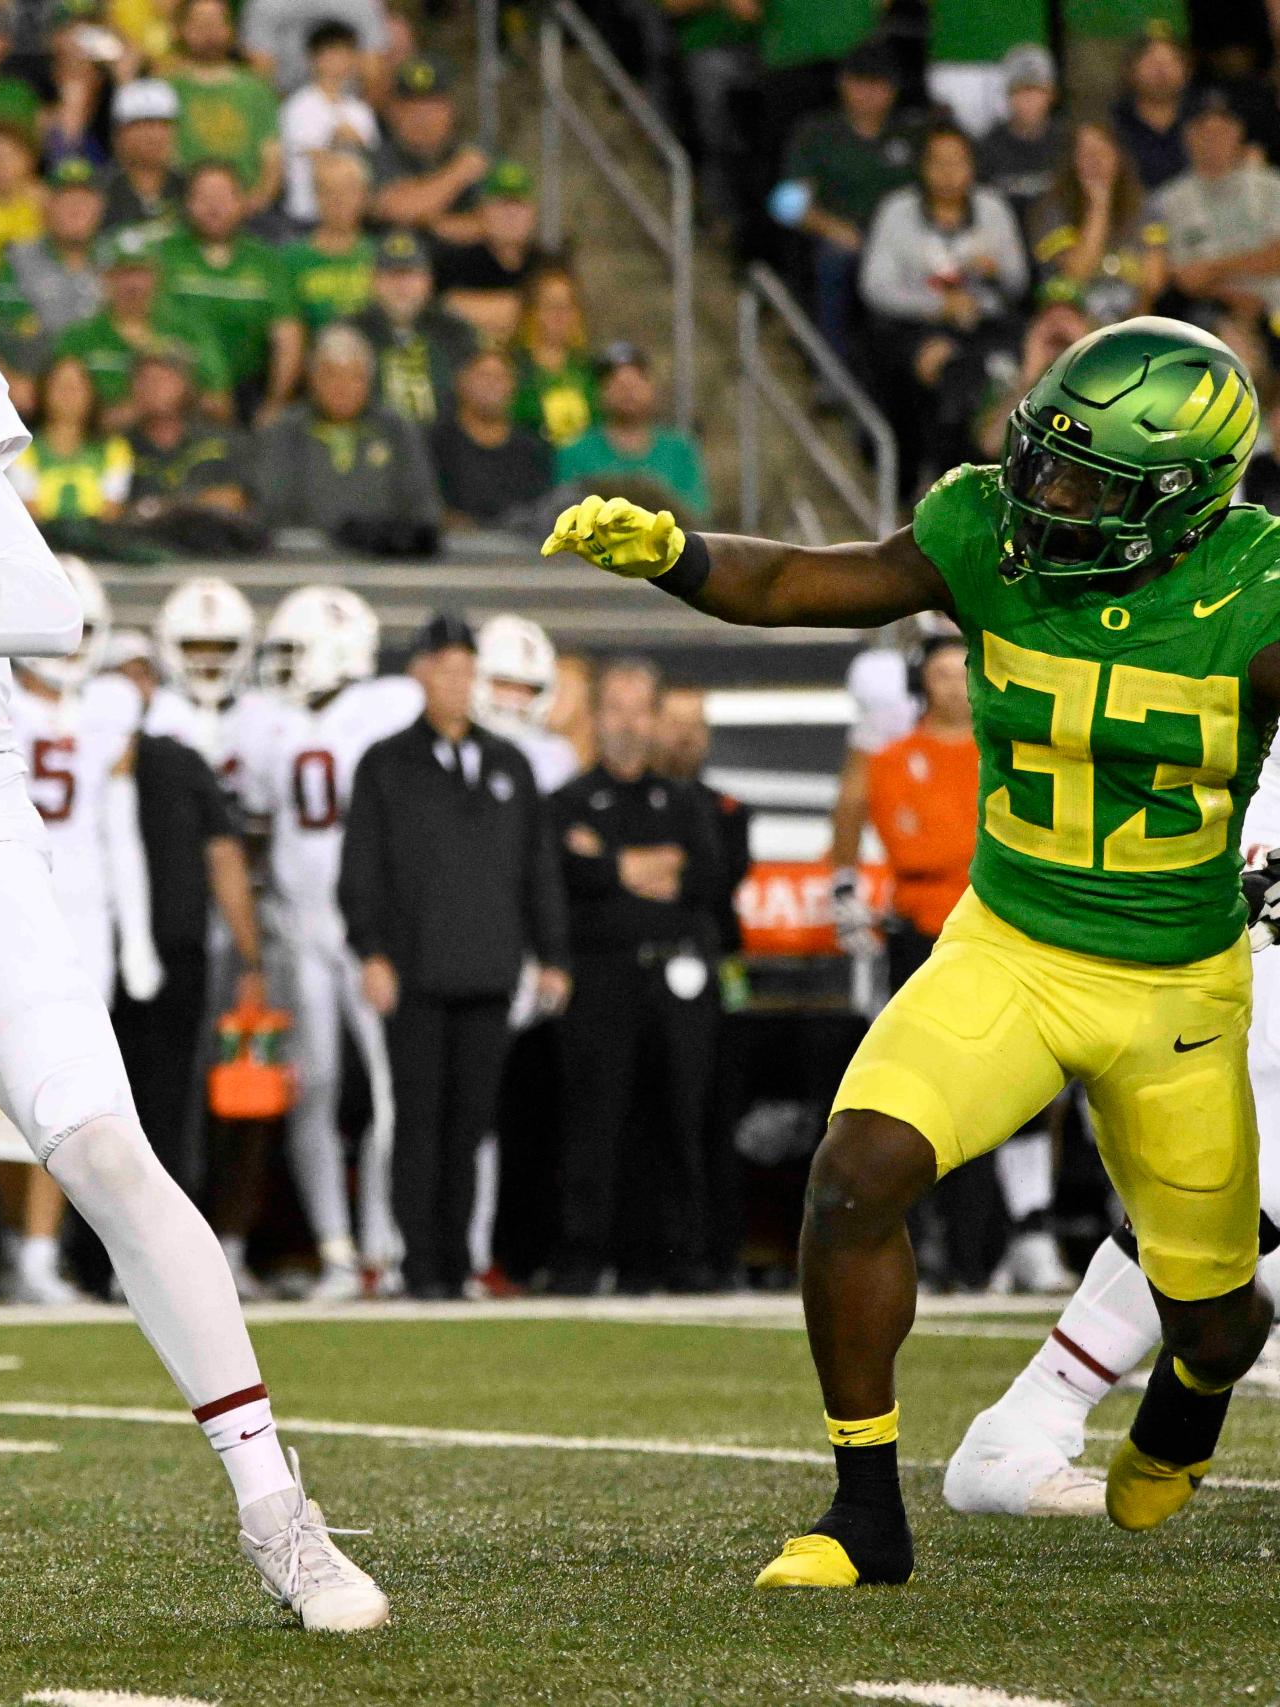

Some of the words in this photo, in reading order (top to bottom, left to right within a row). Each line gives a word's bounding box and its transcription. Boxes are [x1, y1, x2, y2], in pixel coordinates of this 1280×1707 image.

[1051, 413, 1071, 432] O
[1100, 607, 1130, 631] O
[31, 736, 77, 822] 5
[292, 748, 339, 829] 0
[982, 629, 1240, 872] 33
